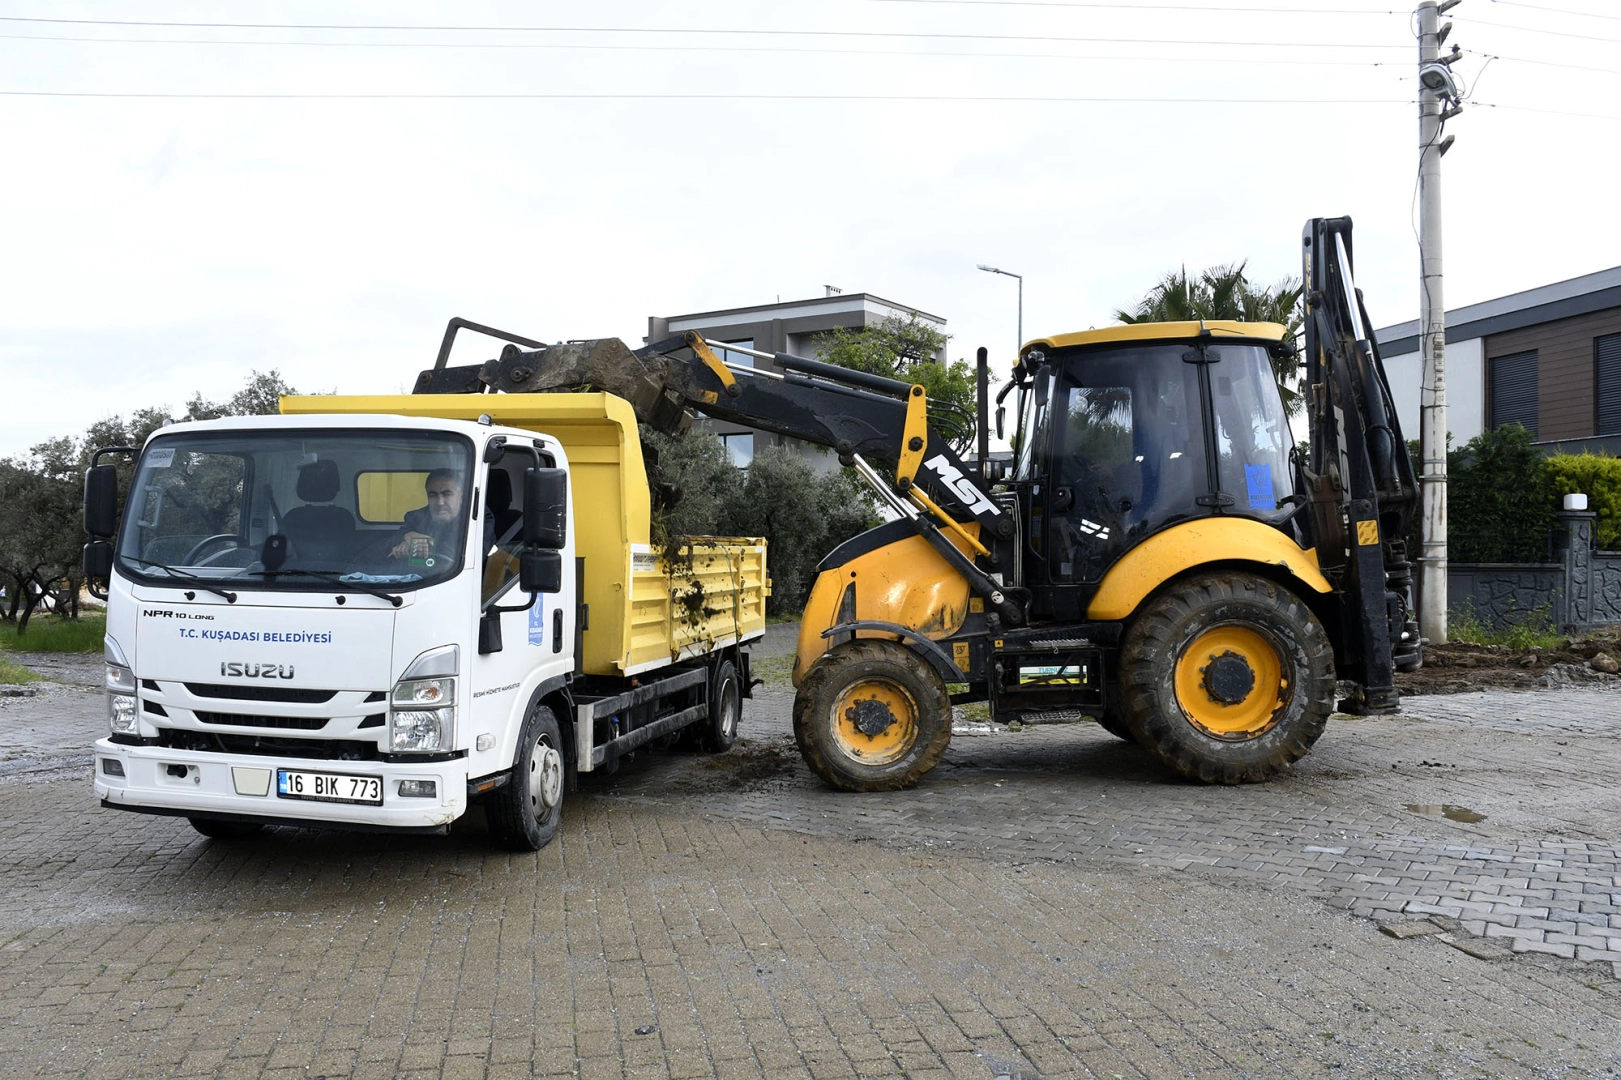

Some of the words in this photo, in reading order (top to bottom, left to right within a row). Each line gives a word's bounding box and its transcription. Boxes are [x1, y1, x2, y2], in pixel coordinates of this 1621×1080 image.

[923, 453, 1002, 517] MST
[143, 609, 173, 618] NPR
[179, 628, 199, 639] T.C.
[201, 630, 260, 643] KUŞADASI
[263, 630, 332, 644] BELEDİYESİ
[220, 661, 295, 680] ISUZU
[288, 774, 304, 793] 16
[315, 776, 339, 796] BIK
[349, 778, 379, 799] 773
